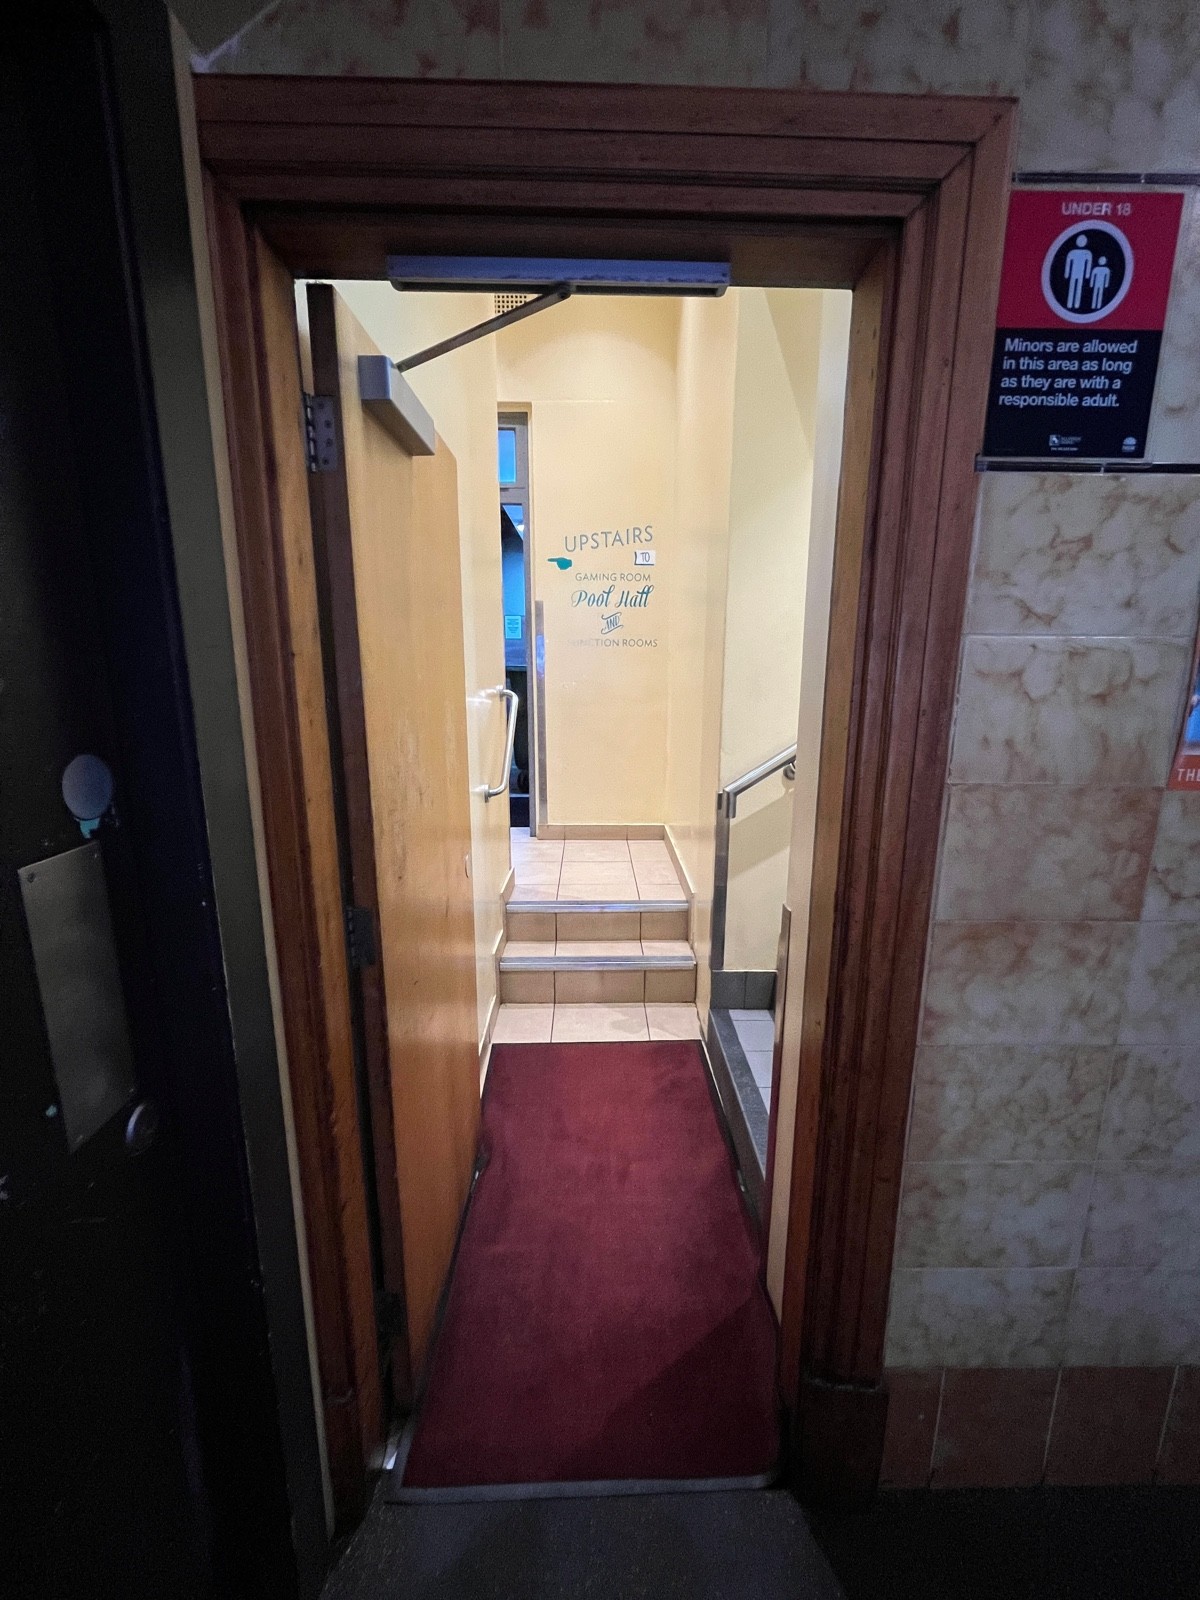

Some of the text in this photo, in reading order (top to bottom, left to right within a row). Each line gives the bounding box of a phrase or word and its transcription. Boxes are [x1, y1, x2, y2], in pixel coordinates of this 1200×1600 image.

[1062, 202, 1131, 216] UNDER 18
[1005, 338, 1138, 353] Minors are allowed
[1003, 356, 1132, 374] in this area as long
[1001, 374, 1121, 391] as they are with a
[999, 393, 1119, 408] responsible adult.
[565, 525, 653, 552] UPSTAIRS
[640, 552, 650, 562] TO
[575, 573, 651, 581] GAMING ROOM
[571, 584, 654, 608] Pool Hall
[567, 638, 658, 647] TION ROOMS
